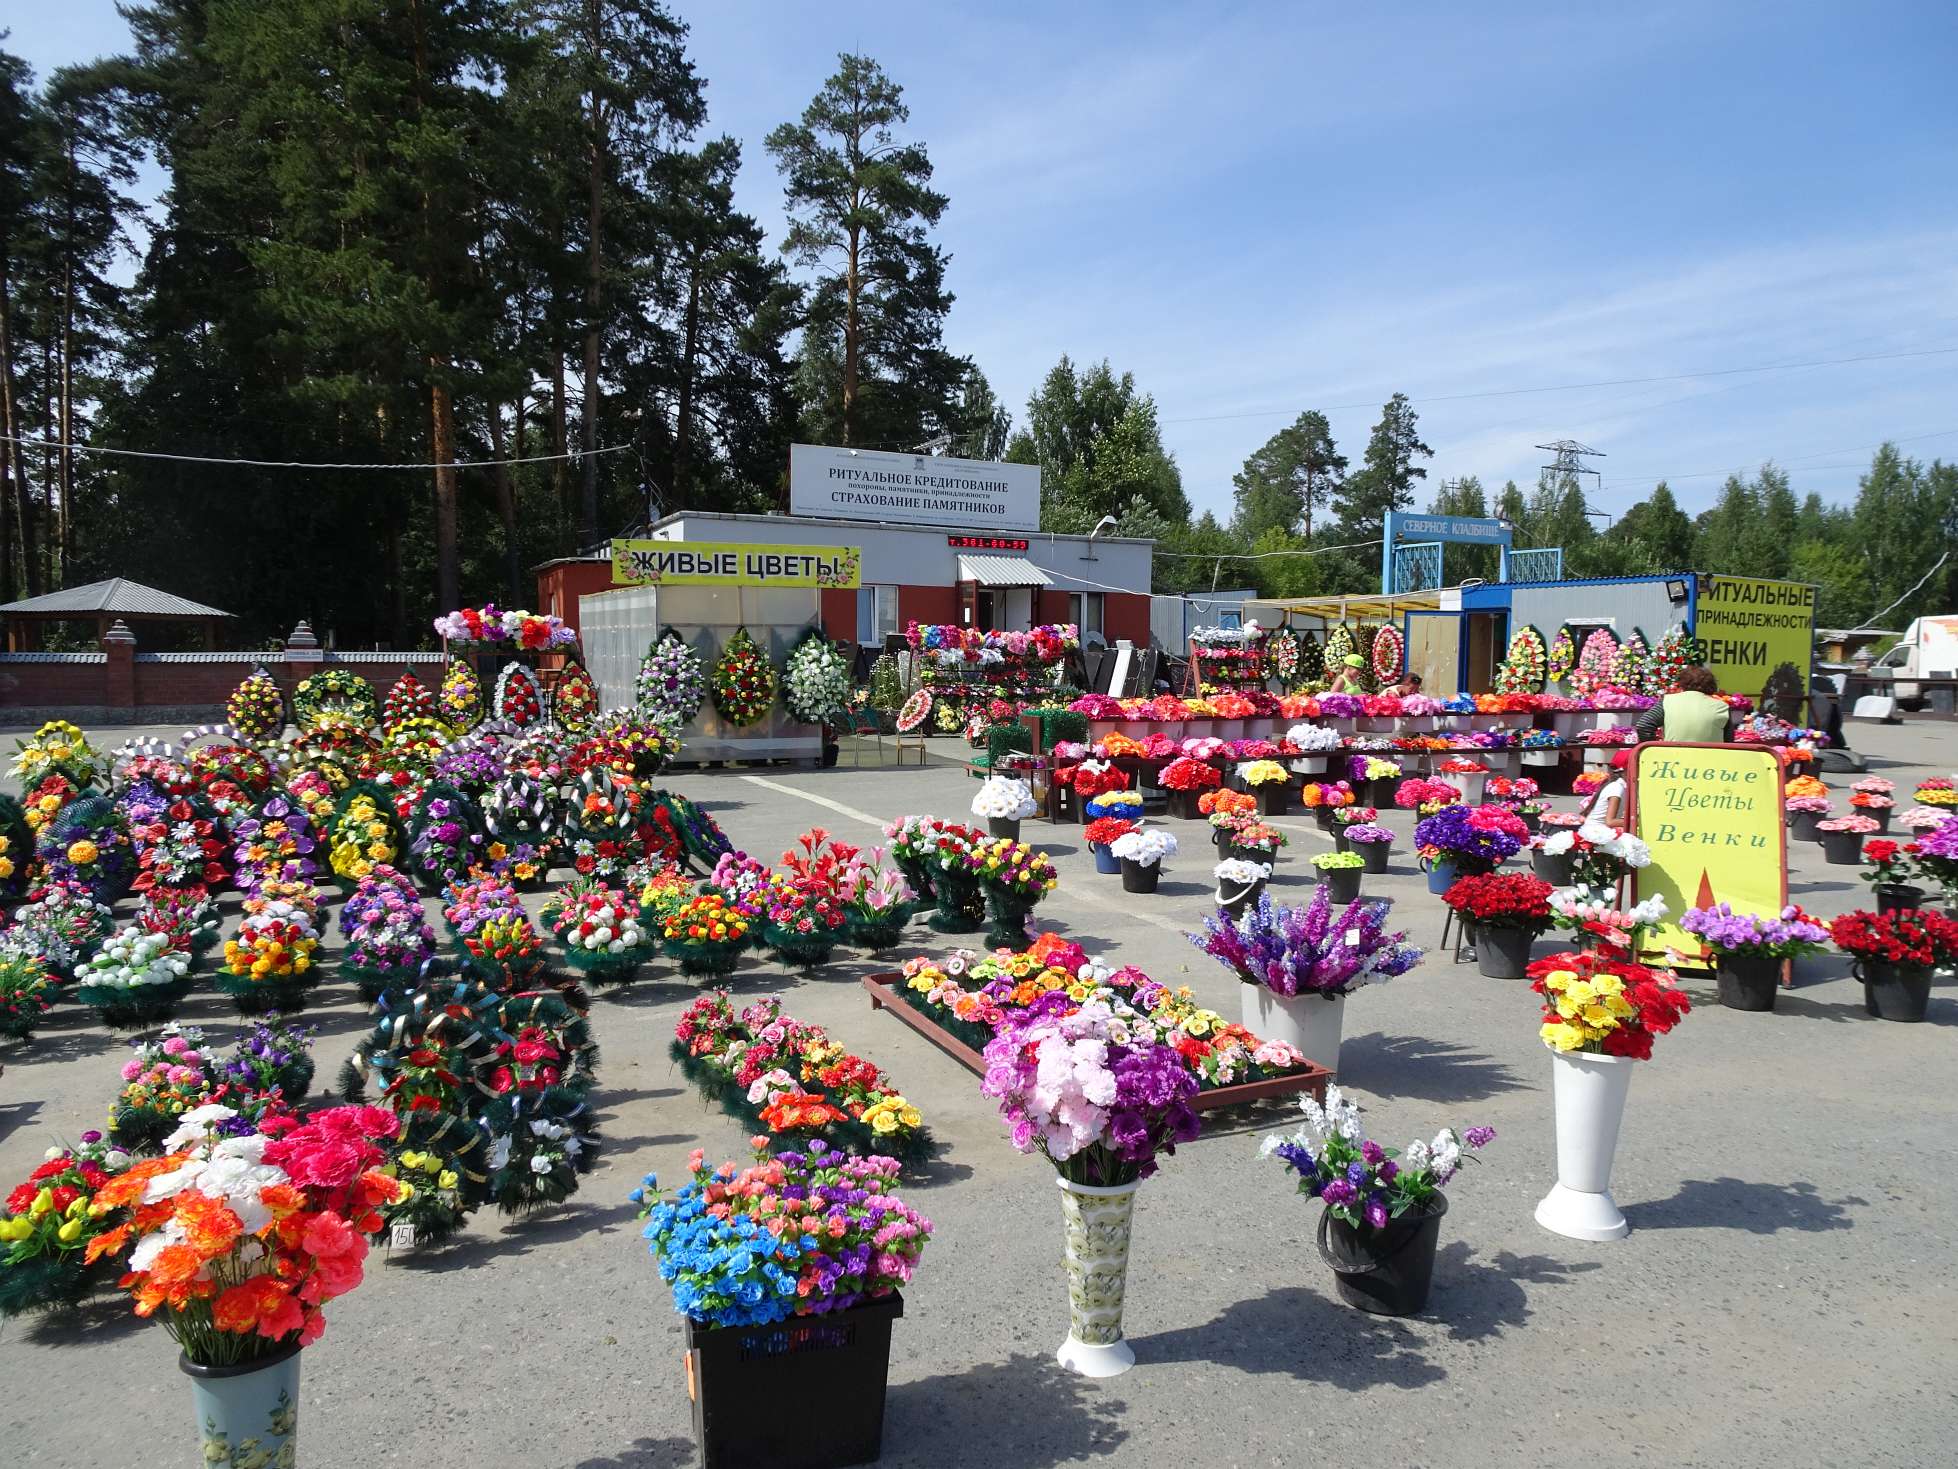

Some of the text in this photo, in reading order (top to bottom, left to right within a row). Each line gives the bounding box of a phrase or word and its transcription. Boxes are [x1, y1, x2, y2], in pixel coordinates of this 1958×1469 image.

[829, 467, 1009, 493] РИТУАЛЬНОЕ КРЕДИТОВАНИЕ
[831, 491, 1005, 515] СТРАХОВАНИЕ ПАМЯТНИКОВ
[1403, 519, 1448, 535] СЕВЕРНОЕ
[631, 551, 839, 579] ЖИВЫЕ ЦВЕТЫ
[1696, 609, 1812, 629] ПРИНАДЛЕЖНОСТИ
[1695, 639, 1767, 666] ВЕНКИ
[1650, 761, 1758, 783] Живые
[1665, 787, 1754, 812] Цветы
[1656, 824, 1767, 848] Венки
